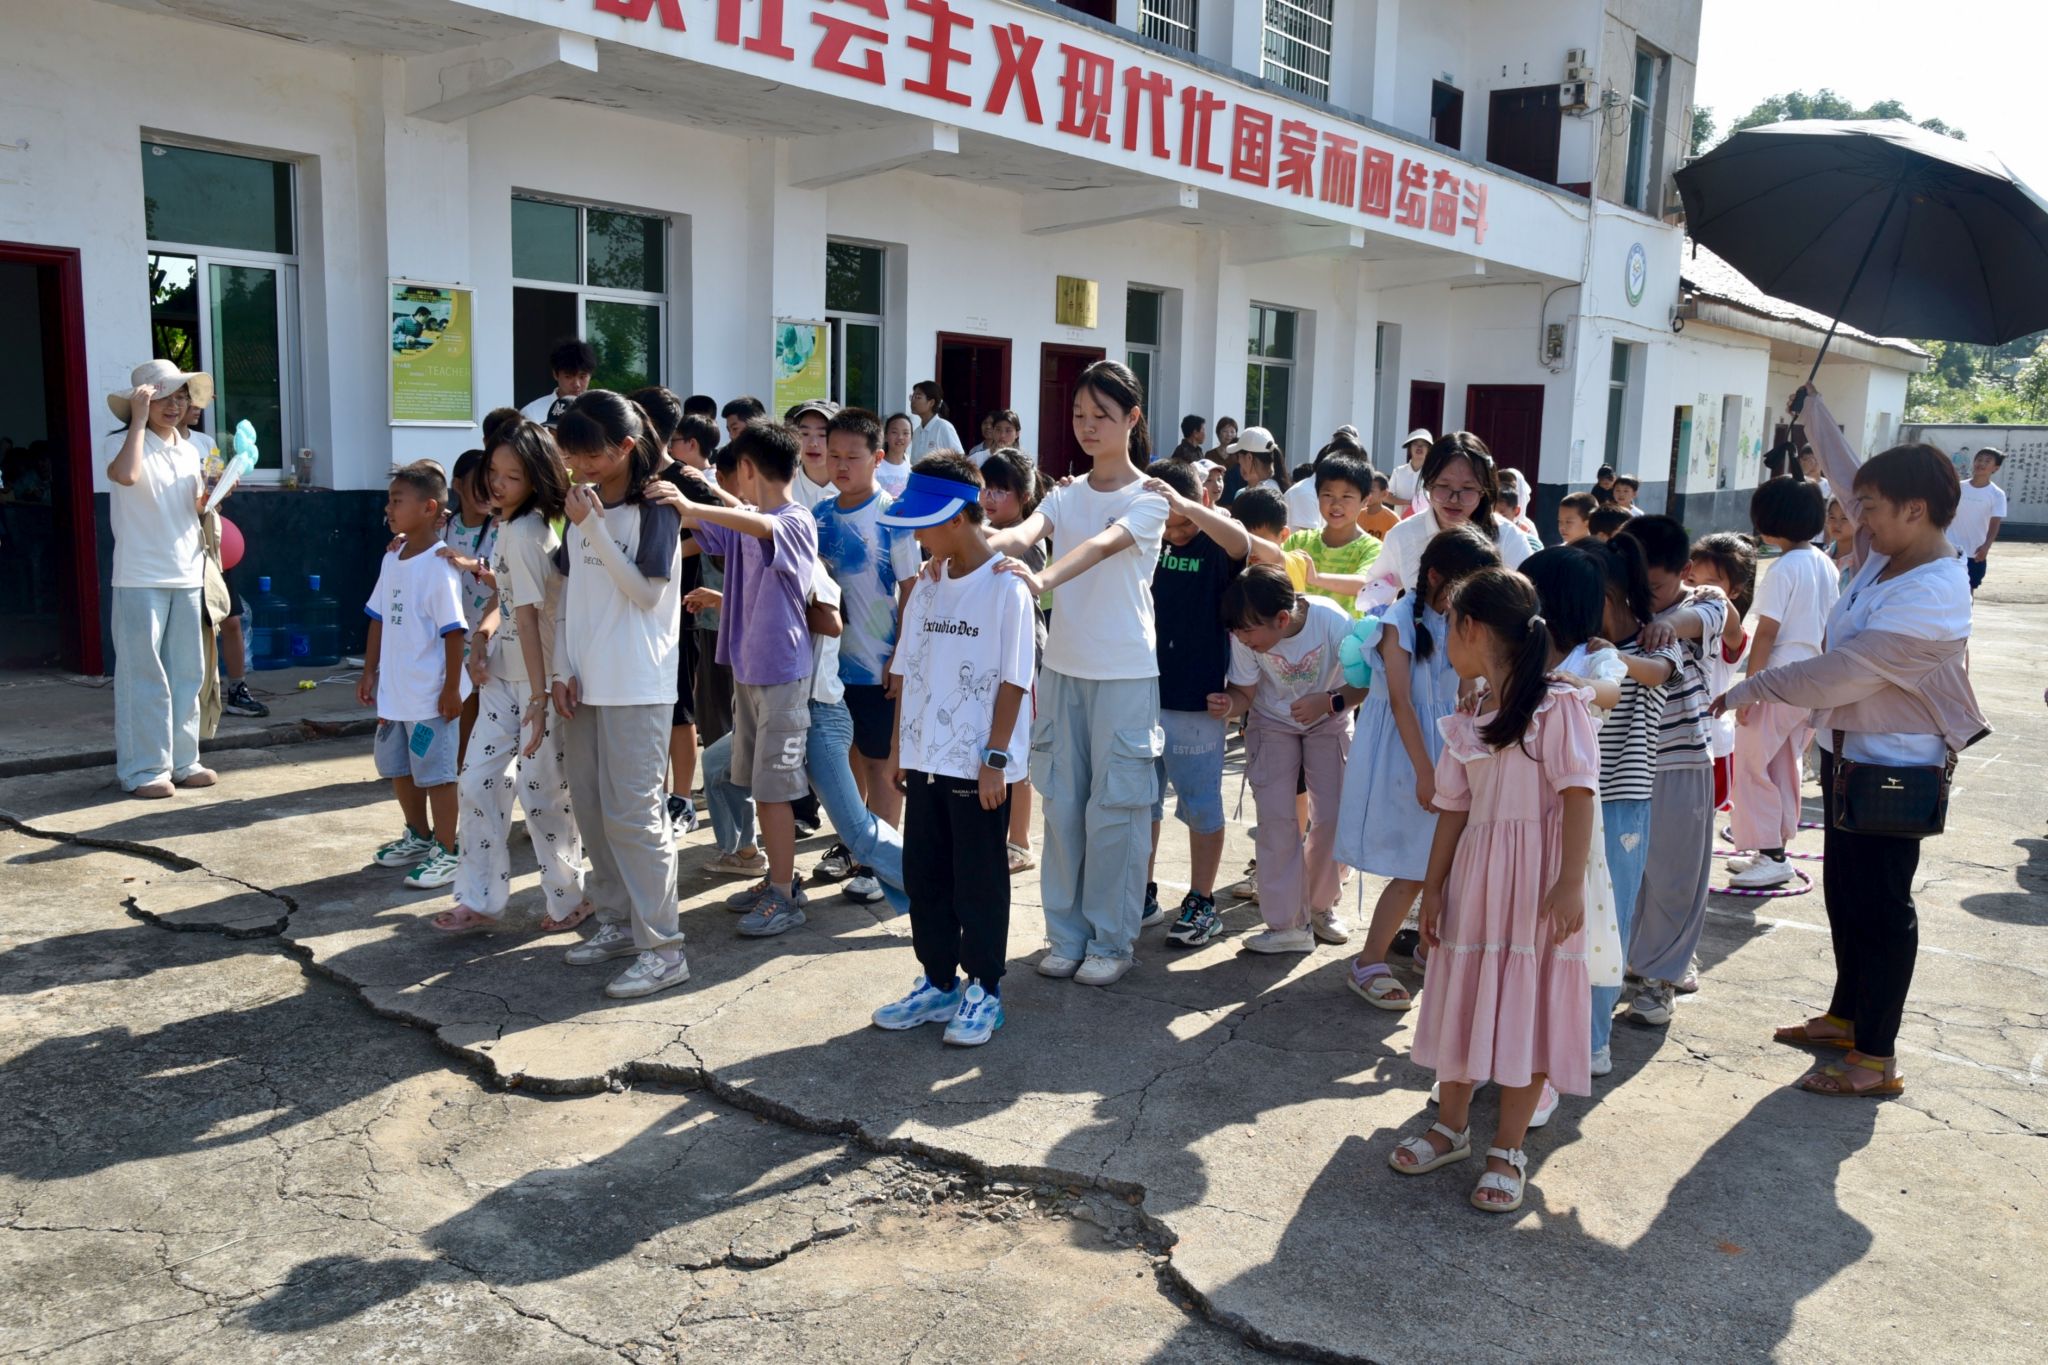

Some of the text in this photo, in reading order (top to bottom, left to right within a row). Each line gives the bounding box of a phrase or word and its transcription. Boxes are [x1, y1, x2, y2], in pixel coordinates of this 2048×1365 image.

[593, 0, 1488, 245] 社会主义现代化国家而团结奋斗
